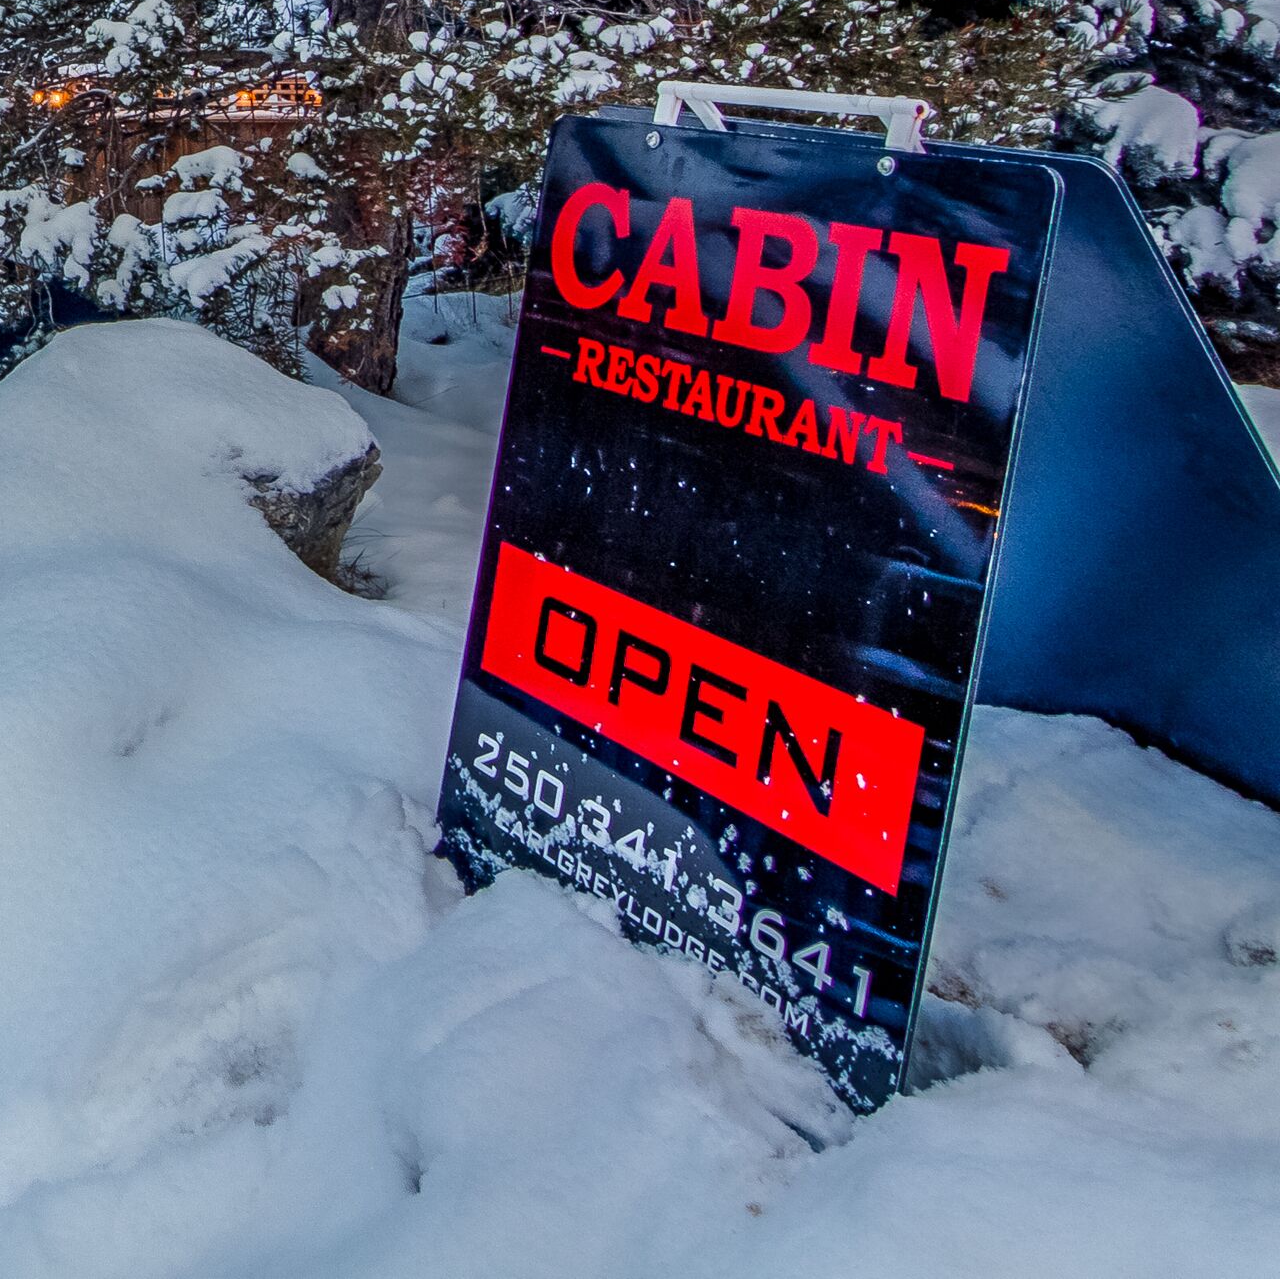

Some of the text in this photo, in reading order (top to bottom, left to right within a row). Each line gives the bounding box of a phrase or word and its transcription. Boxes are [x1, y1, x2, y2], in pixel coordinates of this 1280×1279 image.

[551, 182, 1010, 404] CABIN
[572, 337, 903, 476] RESTAURANT
[534, 596, 843, 818] OPEN
[495, 807, 811, 1039] EARLGREYLODGECOM
